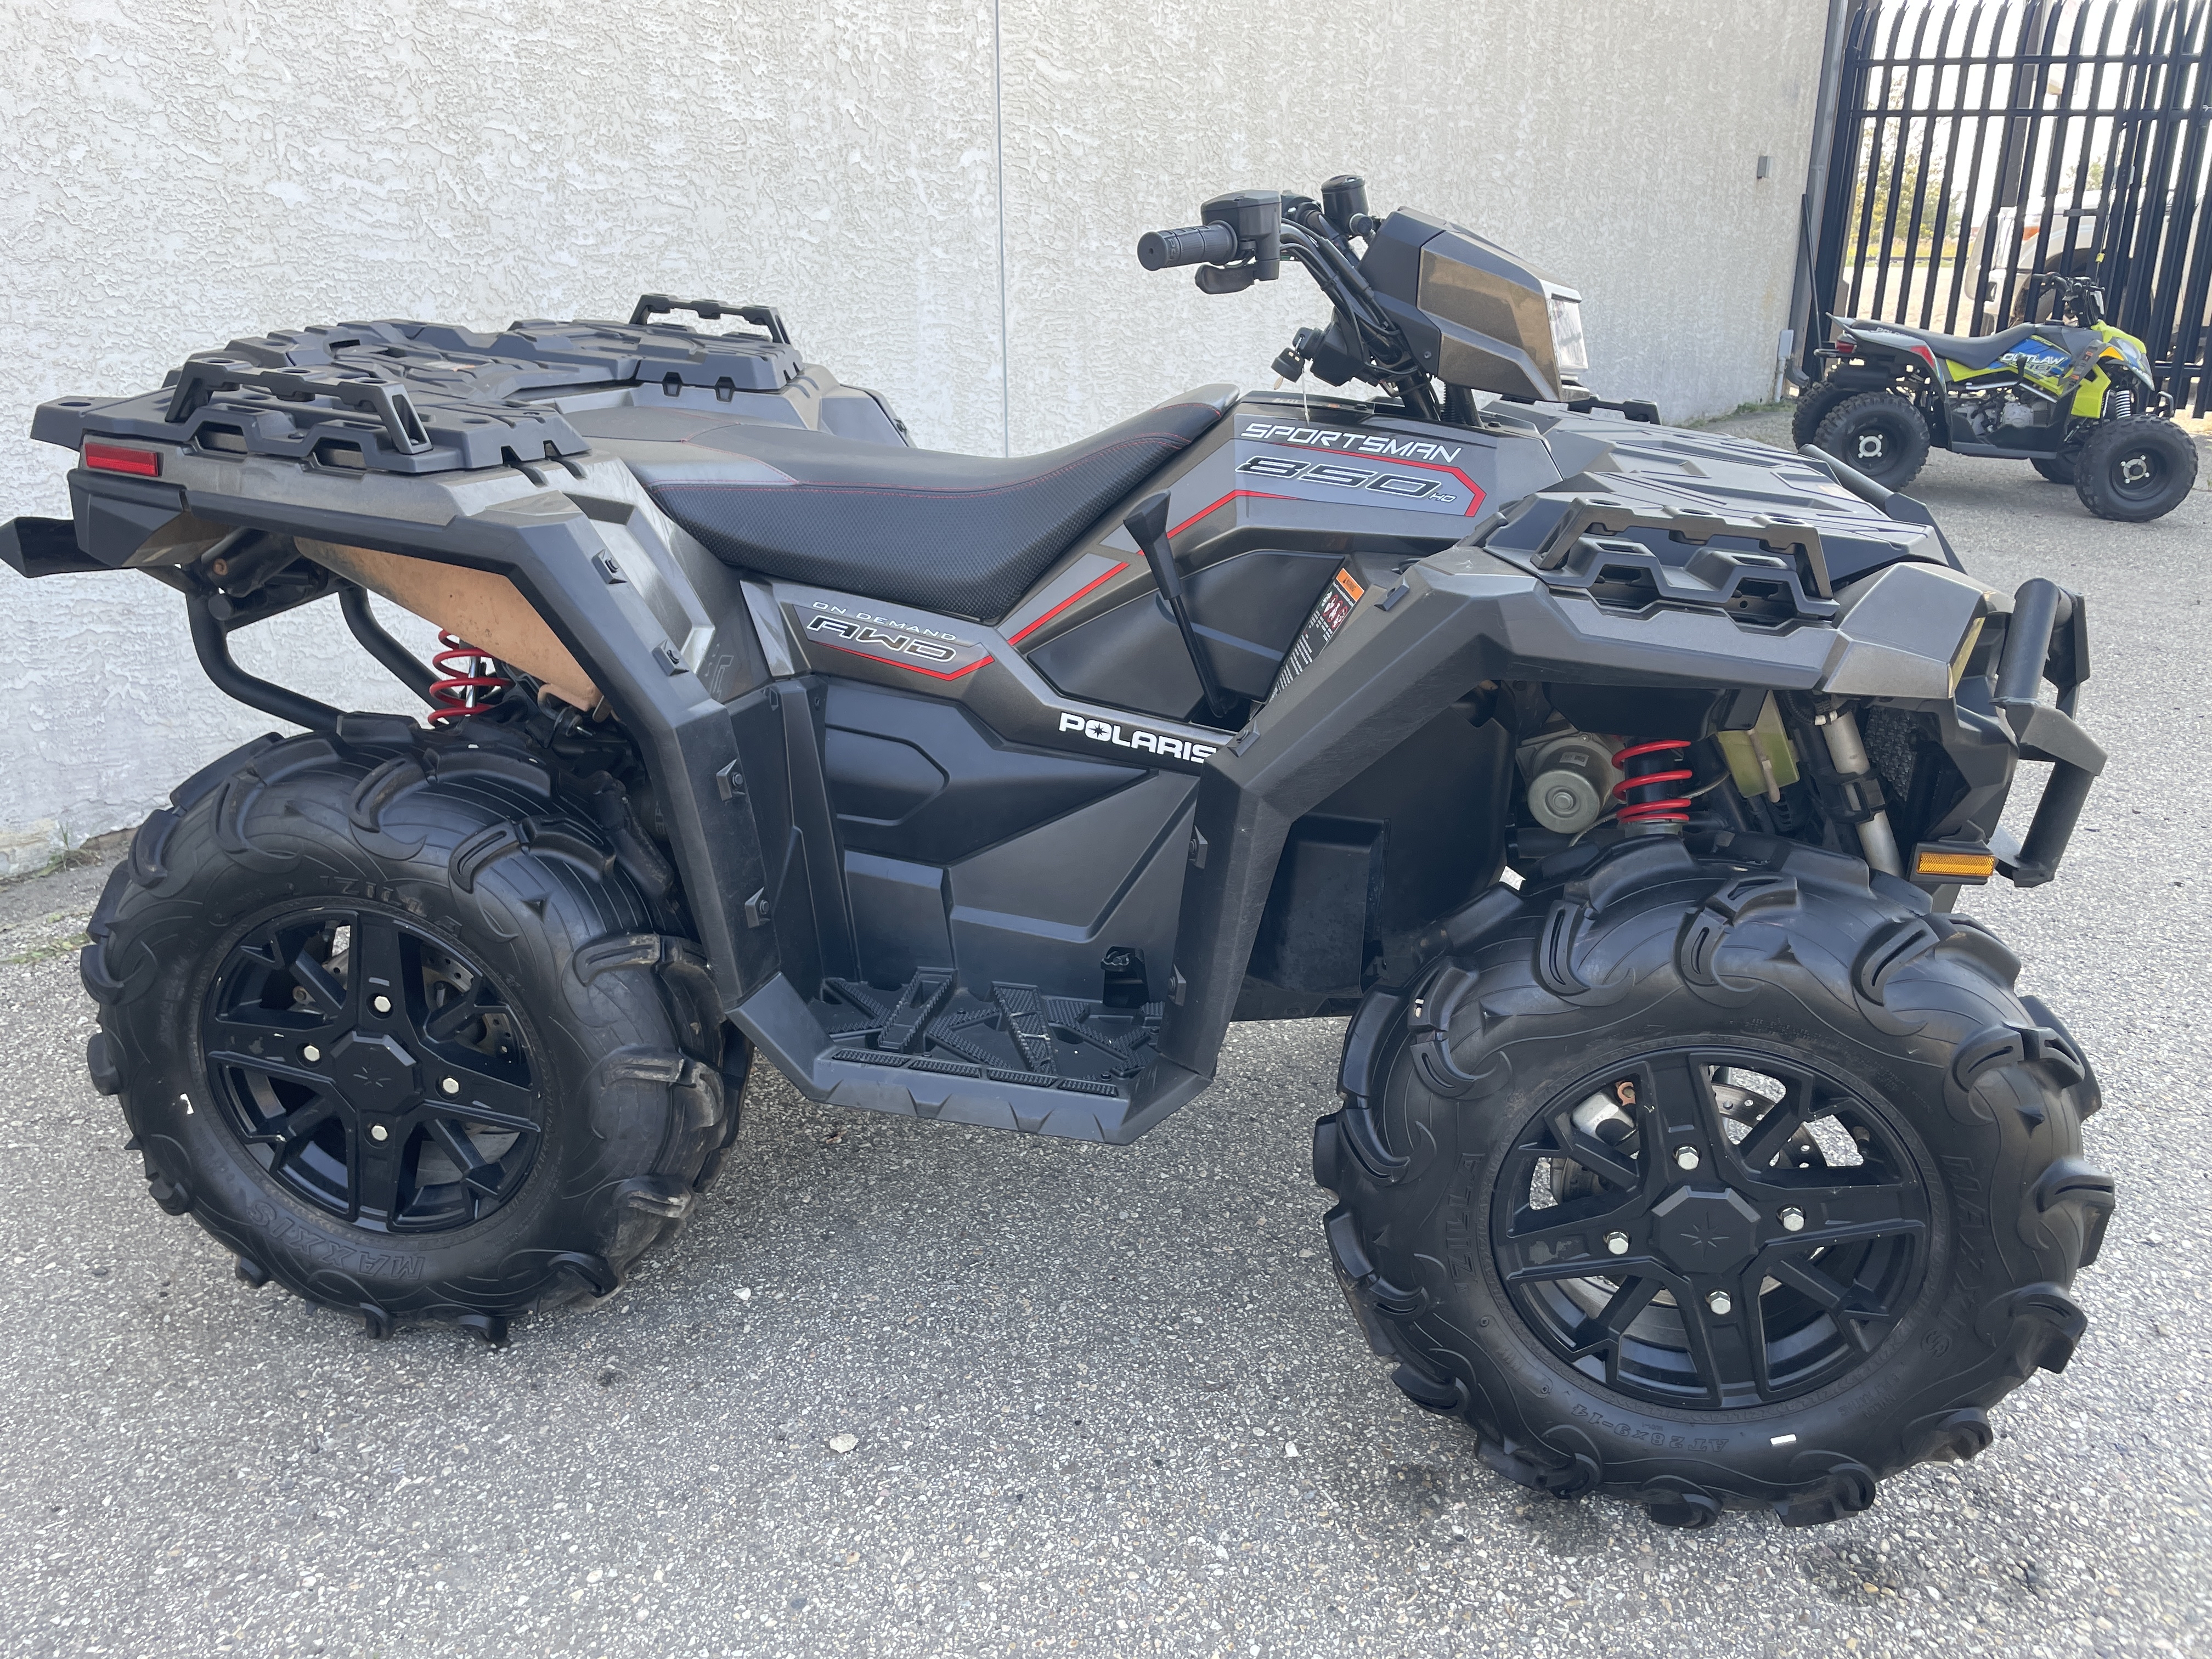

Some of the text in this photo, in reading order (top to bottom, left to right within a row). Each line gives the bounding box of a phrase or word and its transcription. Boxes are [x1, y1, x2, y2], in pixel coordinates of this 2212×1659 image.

[1240, 423, 1462, 463] SPORTSMAN
[1235, 456, 1442, 499] 850
[806, 615, 957, 662] AWD
[812, 601, 956, 641] ON DEMAND
[1059, 712, 1223, 764] POLARIS
[246, 1200, 426, 1280] MAXXIS
